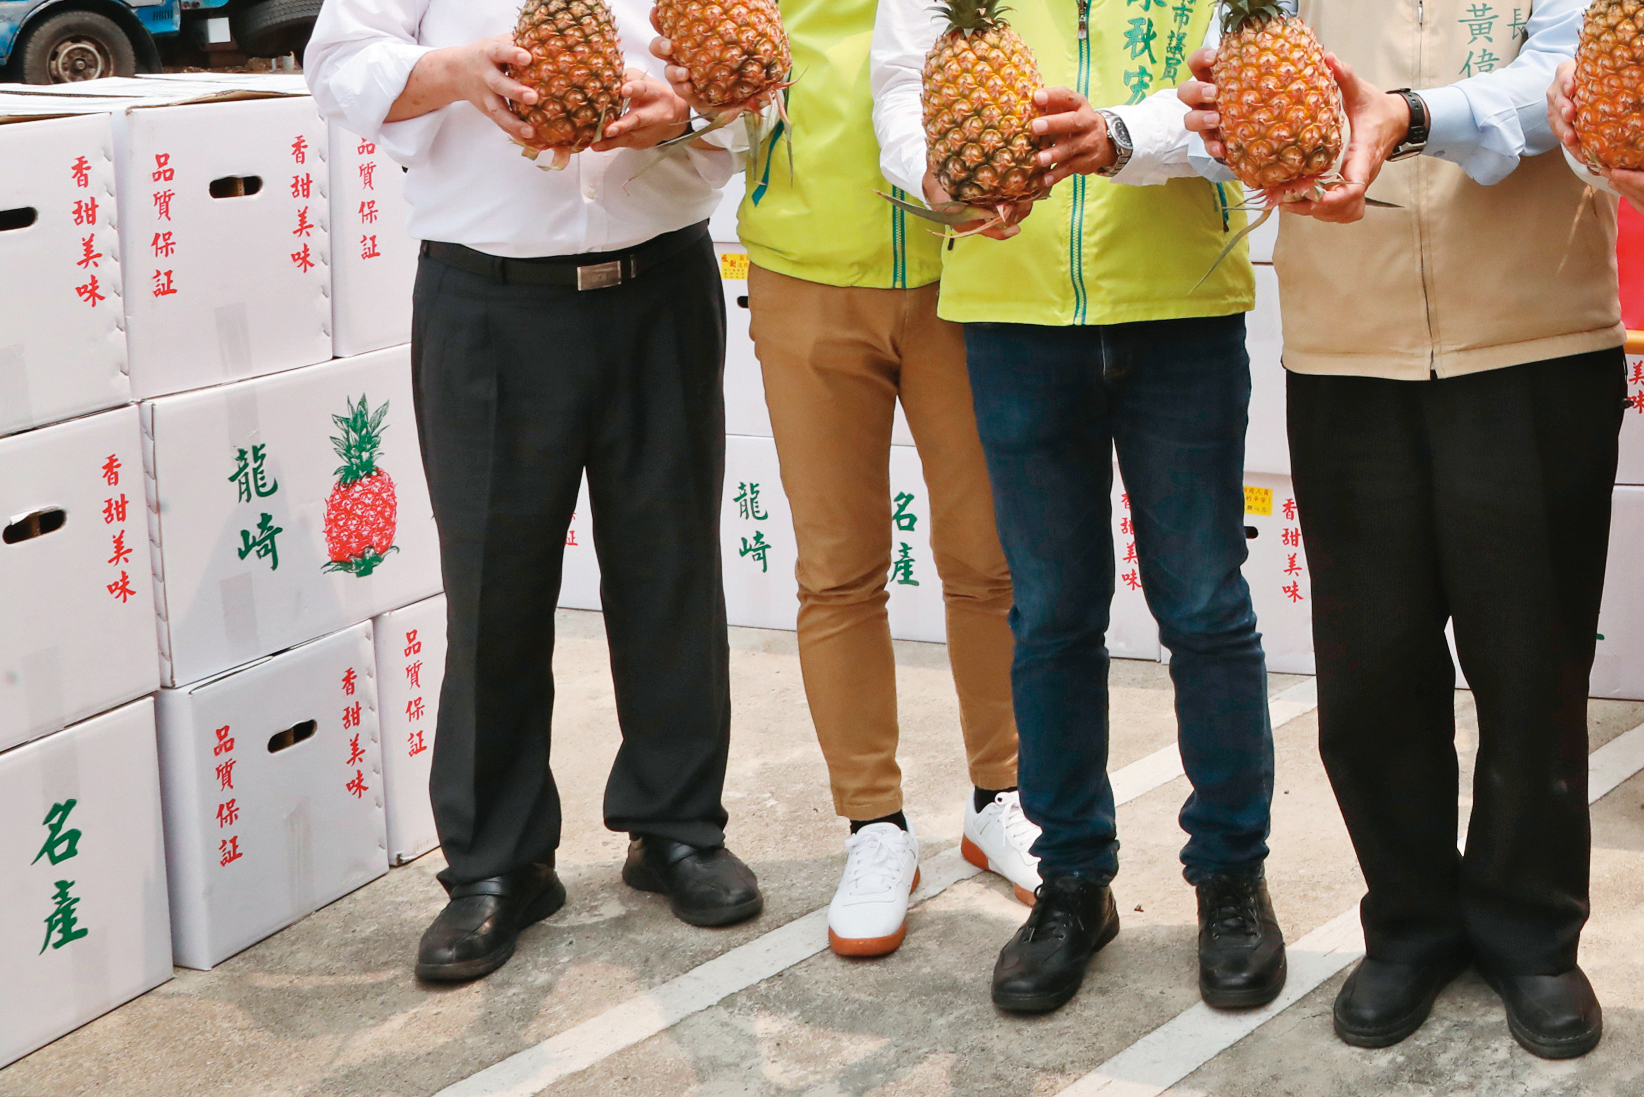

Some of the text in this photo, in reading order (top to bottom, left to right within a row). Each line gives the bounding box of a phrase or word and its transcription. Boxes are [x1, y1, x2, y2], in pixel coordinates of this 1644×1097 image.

[71, 156, 105, 307] 香甜美味
[290, 135, 315, 273] 香甜美味
[101, 454, 137, 603] 香甜美味
[228, 442, 284, 571] 龍崎
[732, 482, 772, 573] 龍崎
[1281, 498, 1304, 603] 香甜美味
[213, 725, 243, 867] 品質保証
[342, 667, 369, 799] 香甜美味
[31, 798, 89, 956] 名產
